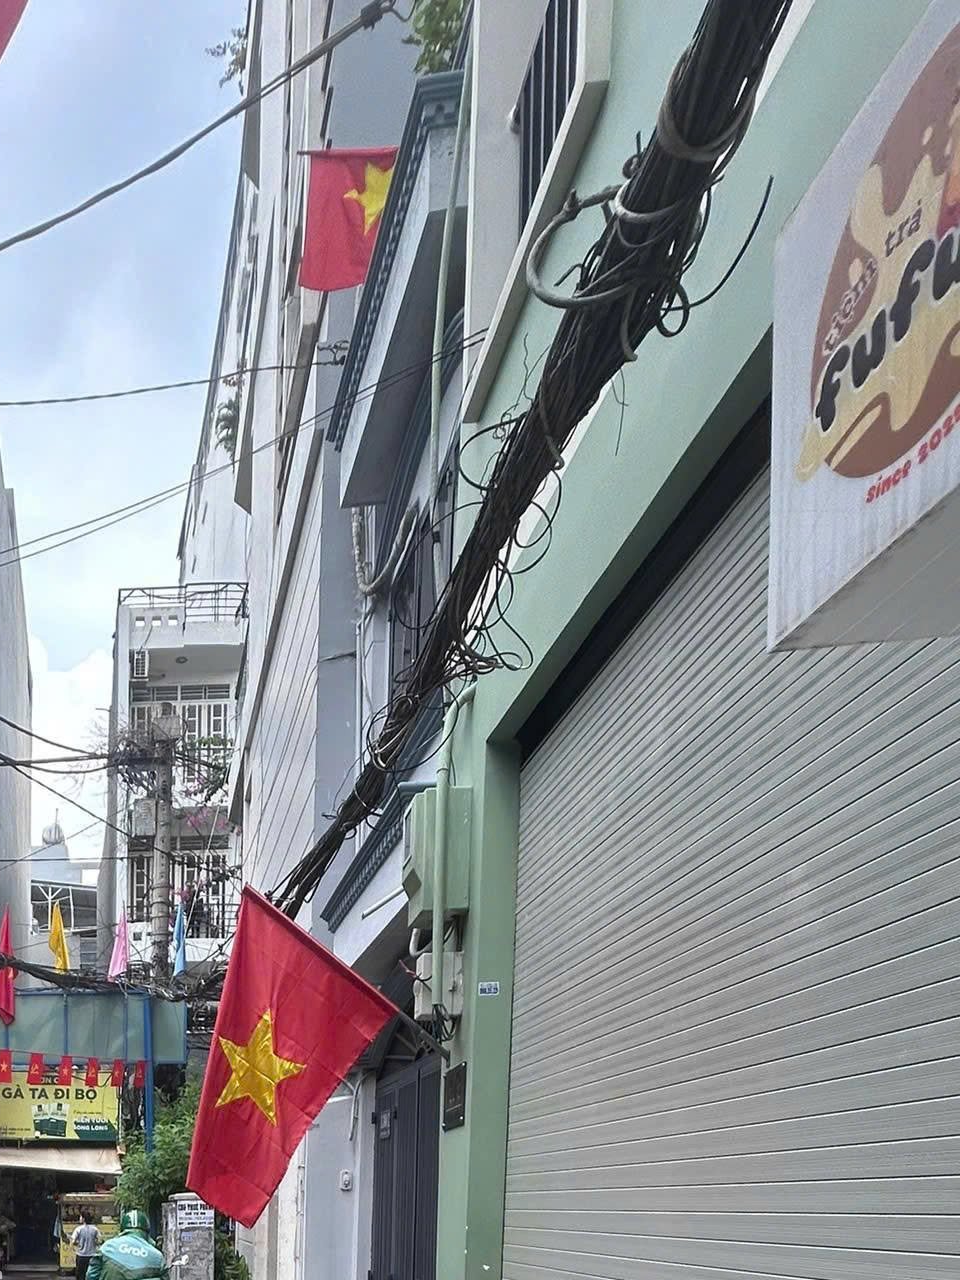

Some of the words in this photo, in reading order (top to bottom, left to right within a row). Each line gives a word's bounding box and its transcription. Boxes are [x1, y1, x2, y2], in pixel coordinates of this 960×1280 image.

[866, 460, 912, 503] since
[2, 1084, 25, 1100] GÀ
[29, 1088, 49, 1100] TA
[54, 1088, 70, 1100] ĐI
[75, 1086, 97, 1103] BỘ
[118, 1243, 148, 1257] Grab
